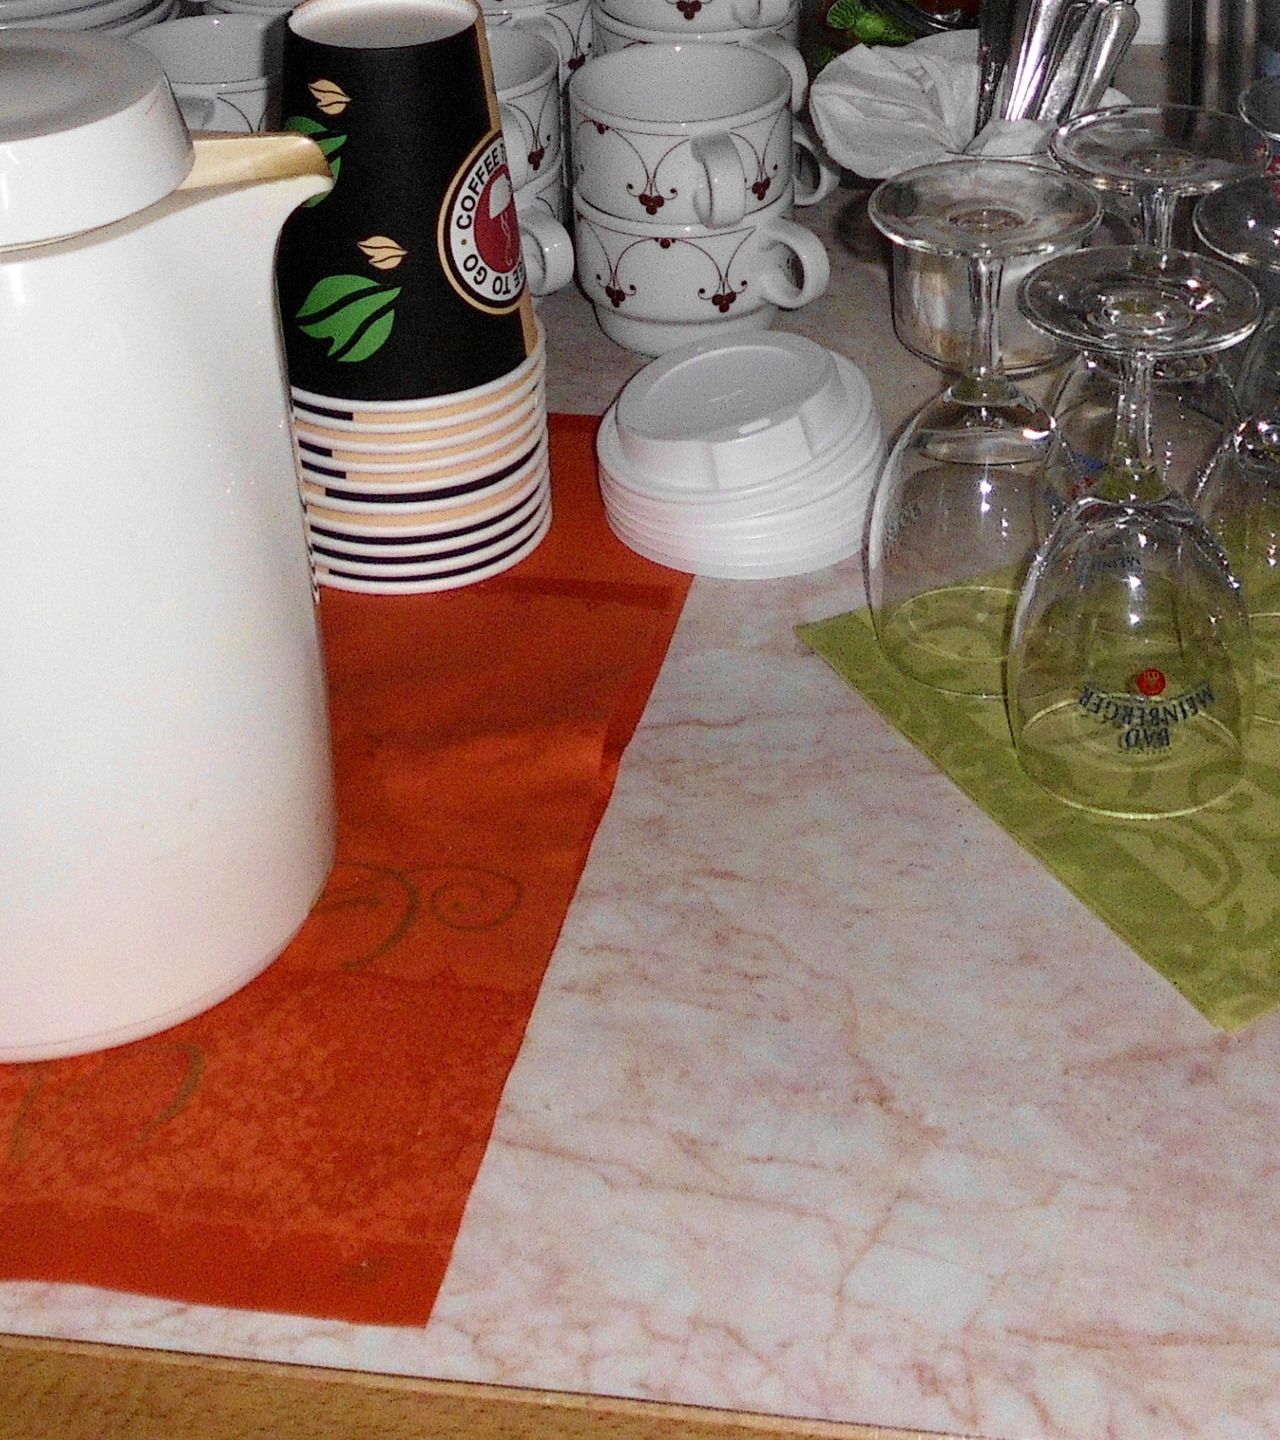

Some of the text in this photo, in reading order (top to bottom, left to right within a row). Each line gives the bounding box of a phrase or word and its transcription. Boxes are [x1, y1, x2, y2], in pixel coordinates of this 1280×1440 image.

[456, 147, 500, 229] COFFEE
[463, 254, 488, 285] GO
[492, 275, 511, 295] TO
